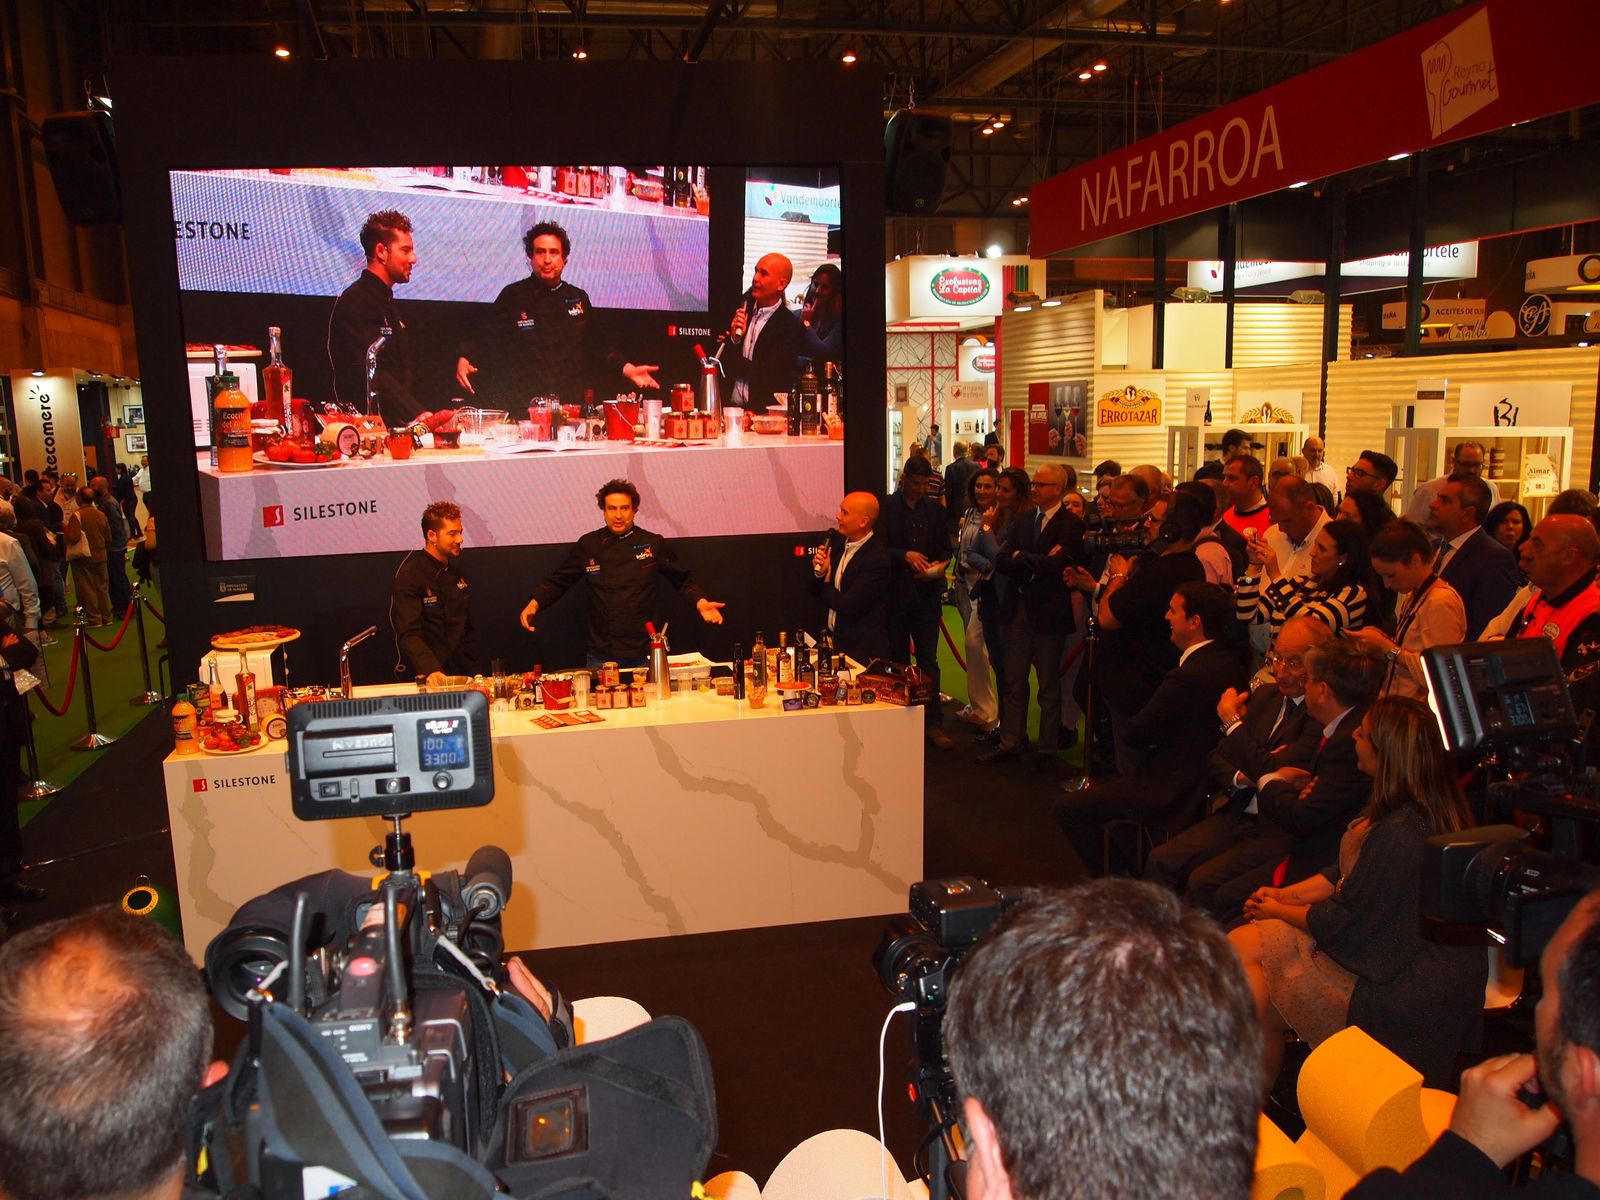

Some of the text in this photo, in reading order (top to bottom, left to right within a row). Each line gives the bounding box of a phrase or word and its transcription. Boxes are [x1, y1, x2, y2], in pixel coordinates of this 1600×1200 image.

[1453, 61, 1486, 80] Reyno
[1442, 61, 1496, 106] Gourmet
[1080, 104, 1284, 231] NAFARROA
[1435, 308, 1464, 316] ACEITES
[679, 327, 711, 336] SILESTONE
[1100, 408, 1158, 425] ERROTAZAR
[293, 500, 378, 521] SILESTONE
[424, 752, 457, 767] 3300
[213, 774, 277, 789] SILESTONE
